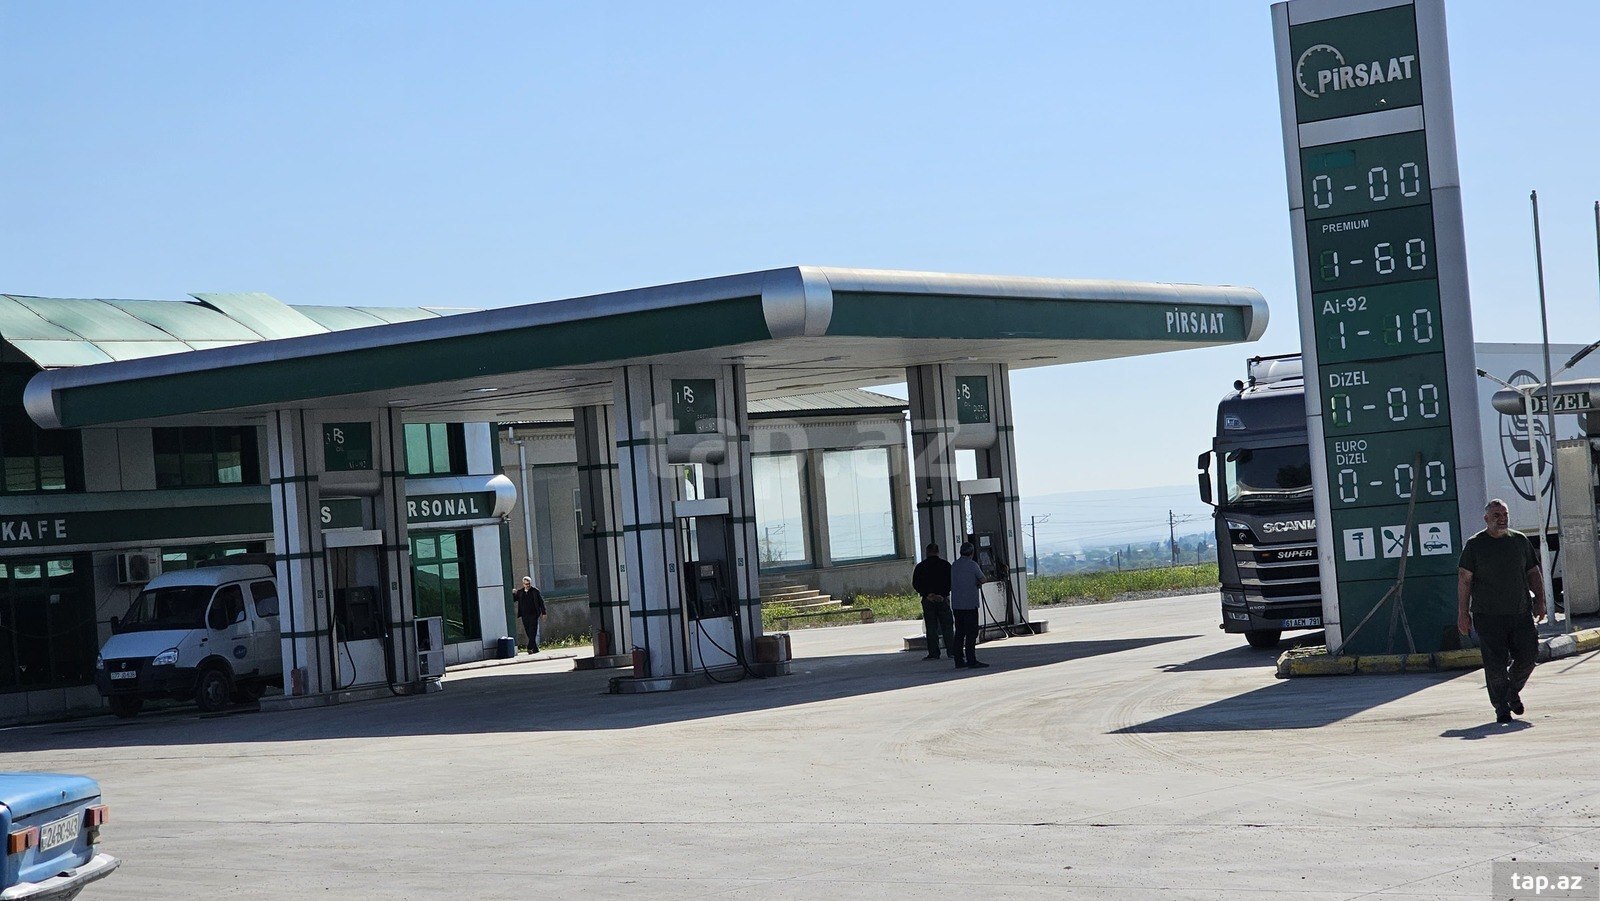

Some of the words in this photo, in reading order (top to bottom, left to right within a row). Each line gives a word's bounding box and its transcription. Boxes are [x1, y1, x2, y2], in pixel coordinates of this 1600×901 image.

[1322, 219, 1369, 233] PREMIUM
[1321, 296, 1367, 315] Ai-92
[1335, 440, 1368, 453] EURO
[407, 497, 479, 518] RSONAL
[1, 519, 67, 541] KAFE
[1277, 549, 1313, 559] SUPER
